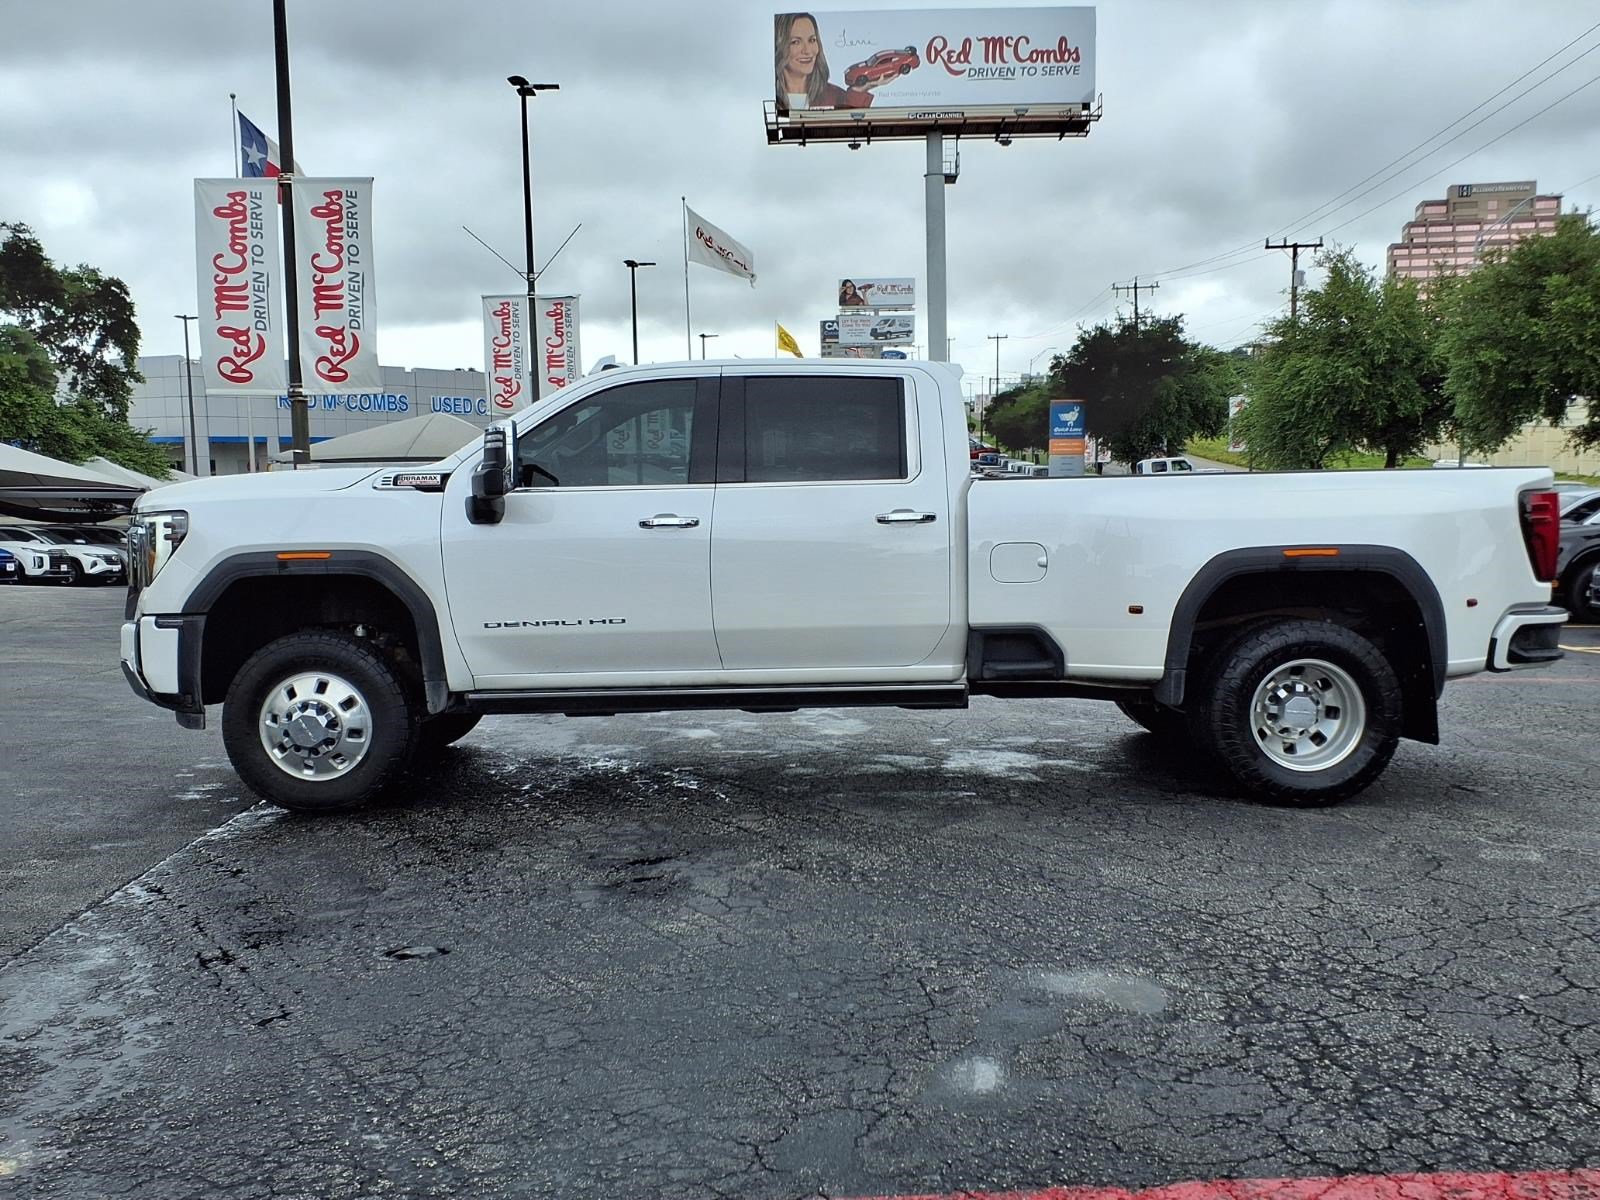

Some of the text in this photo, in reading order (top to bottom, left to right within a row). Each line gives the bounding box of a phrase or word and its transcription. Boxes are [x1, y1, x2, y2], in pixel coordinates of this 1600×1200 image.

[926, 36, 1080, 76] Red McCombs
[967, 65, 1080, 78] DRIVEN TO SERVE
[213, 190, 266, 384] Red McCombs
[250, 190, 268, 332] DRIVEN TO SERVE
[310, 190, 360, 383] Red McCombs
[346, 189, 361, 331] DRIVEN TO SERVE
[492, 301, 521, 408] Red McCombs
[512, 301, 522, 380] DRIVEN TO SERVE
[546, 302, 565, 374] McCombs
[564, 301, 575, 380] DRIVEN TO SERVE
[279, 394, 316, 409] RD
[431, 397, 473, 414] USED
[477, 398, 488, 414] C
[484, 619, 582, 629] DENALI
